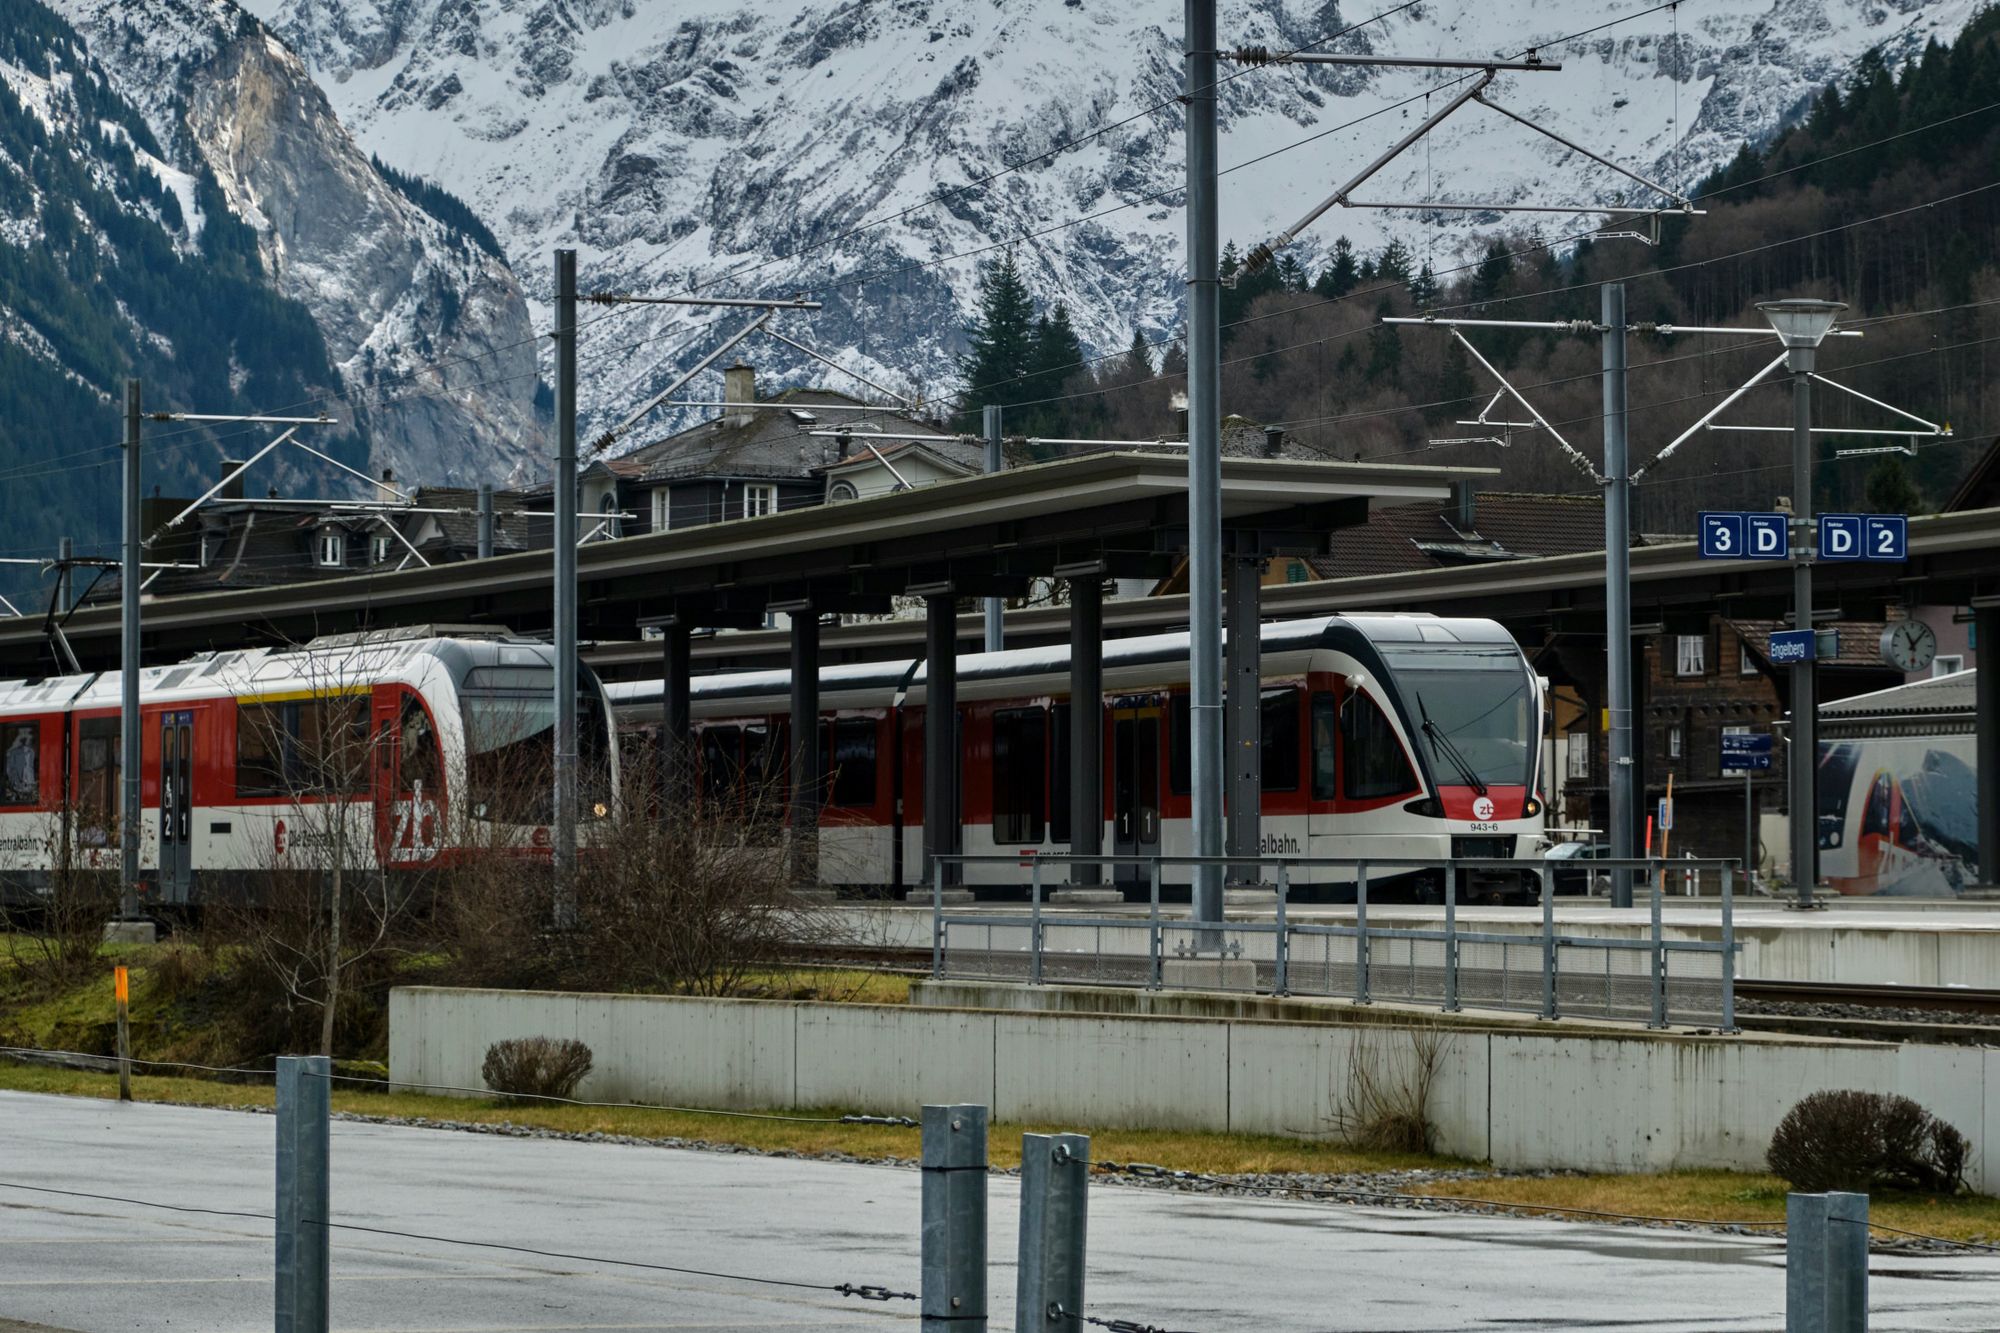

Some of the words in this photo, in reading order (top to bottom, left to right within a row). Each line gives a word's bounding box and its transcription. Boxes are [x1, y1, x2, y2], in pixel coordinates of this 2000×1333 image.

[1715, 527, 1732, 551] 3
[1758, 528, 1777, 551] D
[1832, 529, 1852, 552] D
[1877, 529, 1894, 553] 2
[1771, 641, 1805, 659] Engelberg
[389, 779, 442, 862] zb
[1479, 803, 1494, 815] zb
[164, 813, 171, 836] 2
[181, 812, 187, 835] 1
[1123, 812, 1128, 835] 1
[1145, 811, 1151, 834] 1
[1470, 823, 1498, 831] 943-6
